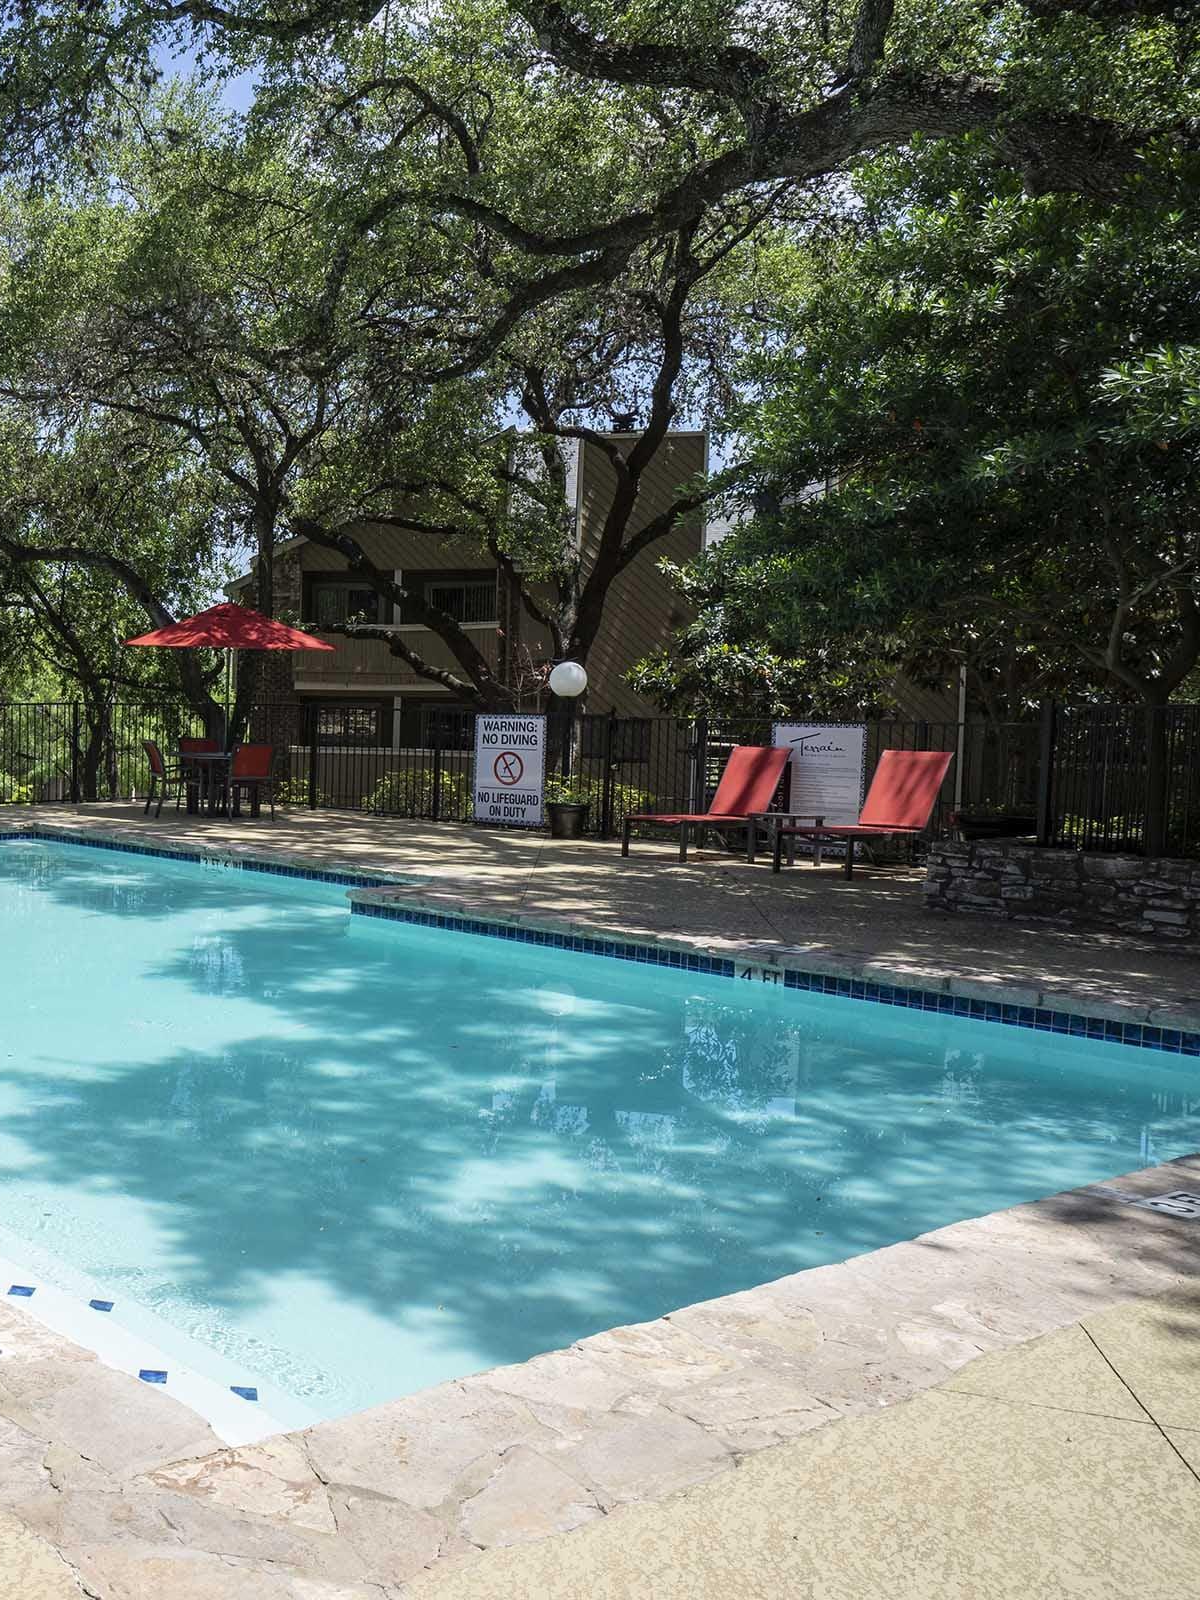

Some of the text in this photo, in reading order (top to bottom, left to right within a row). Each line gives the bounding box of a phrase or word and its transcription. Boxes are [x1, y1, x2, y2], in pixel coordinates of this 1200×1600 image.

[483, 720, 538, 733] WARNING:
[482, 733, 538, 746] NO DIVING
[789, 732, 847, 757] Terrain
[478, 791, 539, 806] NO LIFEGUARD
[489, 805, 527, 818] ON DUTY
[741, 967, 781, 985] 4 FT
